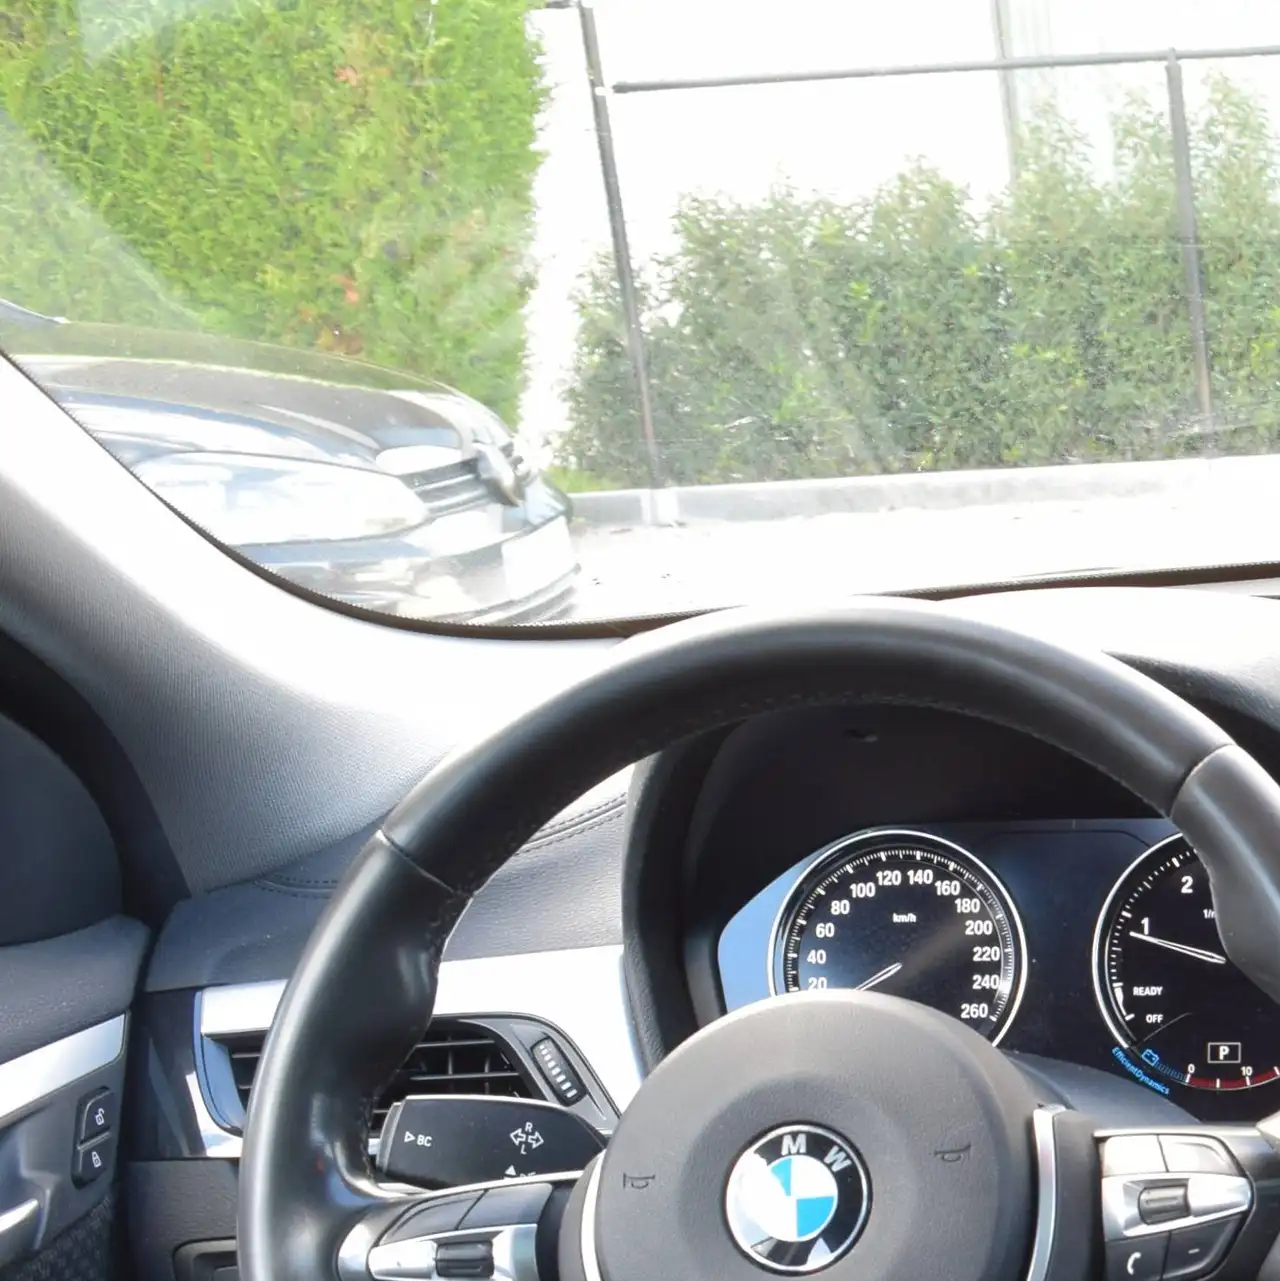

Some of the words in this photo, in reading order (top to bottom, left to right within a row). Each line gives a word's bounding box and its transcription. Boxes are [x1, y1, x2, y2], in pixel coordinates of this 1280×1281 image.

[876, 870, 901, 885] 120
[907, 869, 933, 885] 140
[1181, 876, 1193, 893] 2
[850, 882, 876, 897] 100
[935, 880, 960, 895] 160
[831, 900, 850, 915] 80
[955, 898, 981, 913] 180
[893, 913, 917, 923] km/h
[815, 923, 835, 938] 60
[965, 920, 993, 935] 200
[1141, 917, 1149, 935] 1
[807, 950, 827, 964] 40
[973, 946, 1000, 961] 220
[808, 977, 828, 991] 20
[973, 974, 1000, 990] 240
[1133, 986, 1163, 995] READY
[961, 1003, 988, 1018] 260
[1146, 1014, 1163, 1023] OFF
[1219, 1046, 1229, 1060] P
[1112, 1047, 1170, 1094] EfficientDynamics
[1188, 1064, 1195, 1074] 0
[1241, 1066, 1253, 1076] 10
[525, 1121, 533, 1133] R
[417, 1134, 432, 1147] BC
